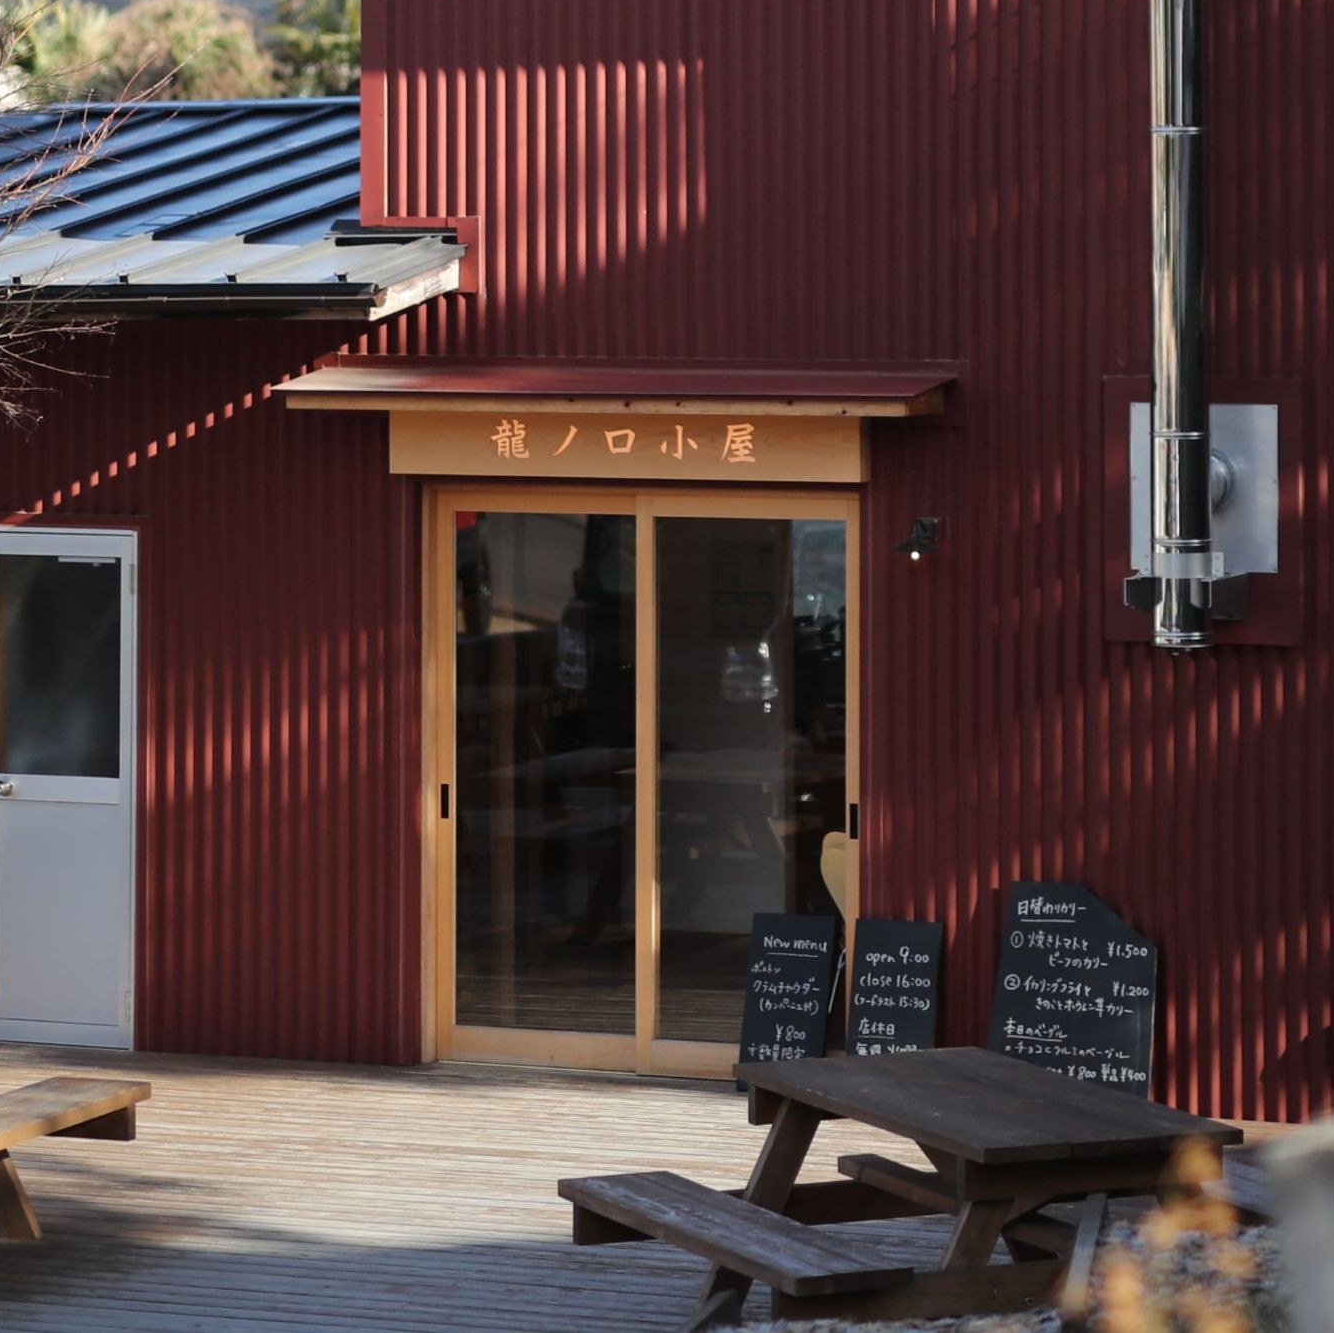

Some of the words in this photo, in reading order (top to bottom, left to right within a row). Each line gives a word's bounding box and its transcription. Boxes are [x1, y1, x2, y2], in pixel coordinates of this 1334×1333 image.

[490, 418, 757, 464] 龍ノ口小屋
[1017, 896, 1087, 916] 日替わりカリー
[763, 935, 790, 948] New
[793, 939, 827, 953] menu
[1027, 929, 1089, 951] 焼きトマトと
[865, 952, 896, 967] open
[899, 945, 930, 965] 9:00
[1048, 951, 1109, 969] ビーフのカリー
[753, 976, 820, 995] クラムチャウダー
[859, 972, 892, 988] close
[896, 974, 931, 988] 16:00
[1023, 975, 1091, 997] イカリングフライと
[858, 1016, 895, 1035] 店休日
